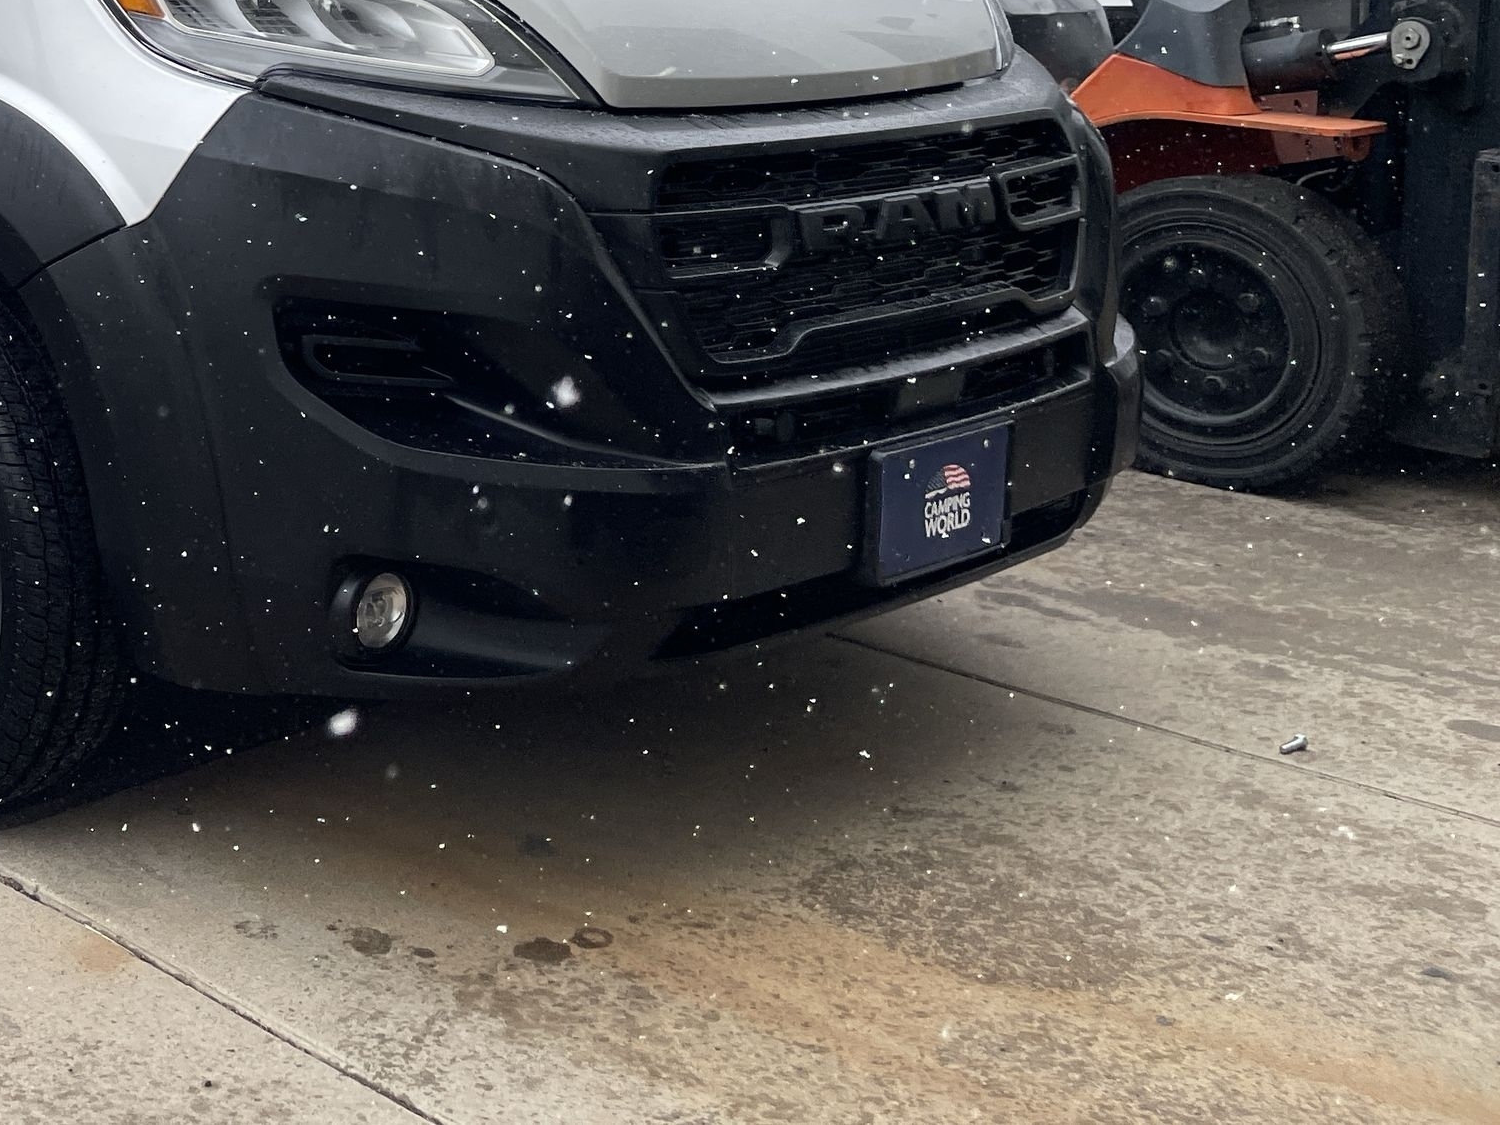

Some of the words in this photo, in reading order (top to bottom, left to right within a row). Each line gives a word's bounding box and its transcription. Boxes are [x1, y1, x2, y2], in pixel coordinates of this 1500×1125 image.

[797, 182, 997, 250] RAM
[924, 491, 971, 519] CAMPING
[924, 509, 971, 538] WORLD
